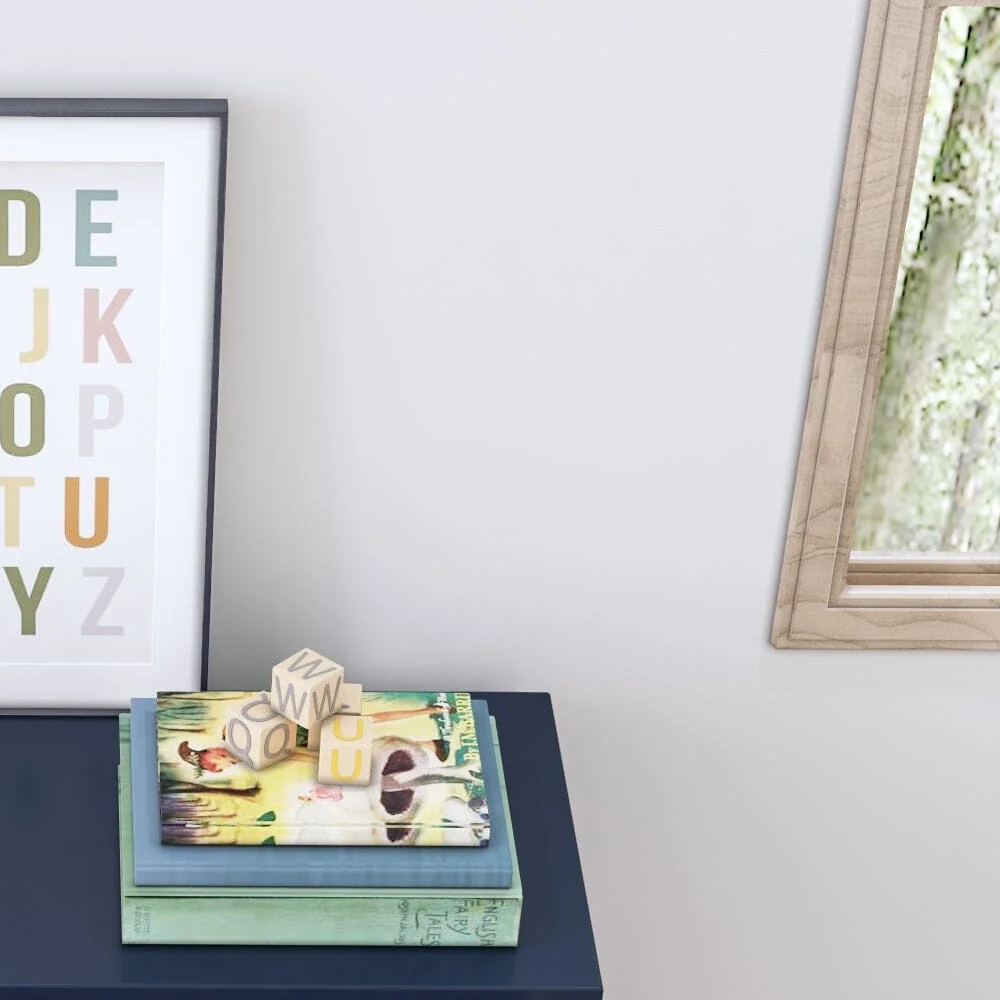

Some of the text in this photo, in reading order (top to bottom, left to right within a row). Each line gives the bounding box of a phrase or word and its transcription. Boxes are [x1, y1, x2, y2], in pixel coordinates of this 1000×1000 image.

[74, 189, 119, 267] E
[18, 287, 50, 363] J
[82, 288, 134, 364] K
[0, 383, 46, 457] O
[78, 384, 124, 456] P
[64, 476, 110, 549] U
[3, 566, 55, 636] Y
[81, 567, 125, 636] Z
[288, 652, 338, 680] W
[275, 675, 308, 724] W
[313, 675, 342, 721] W
[228, 718, 254, 767] Q
[264, 723, 293, 759] Q
[333, 716, 364, 741] U
[331, 748, 362, 782] U
